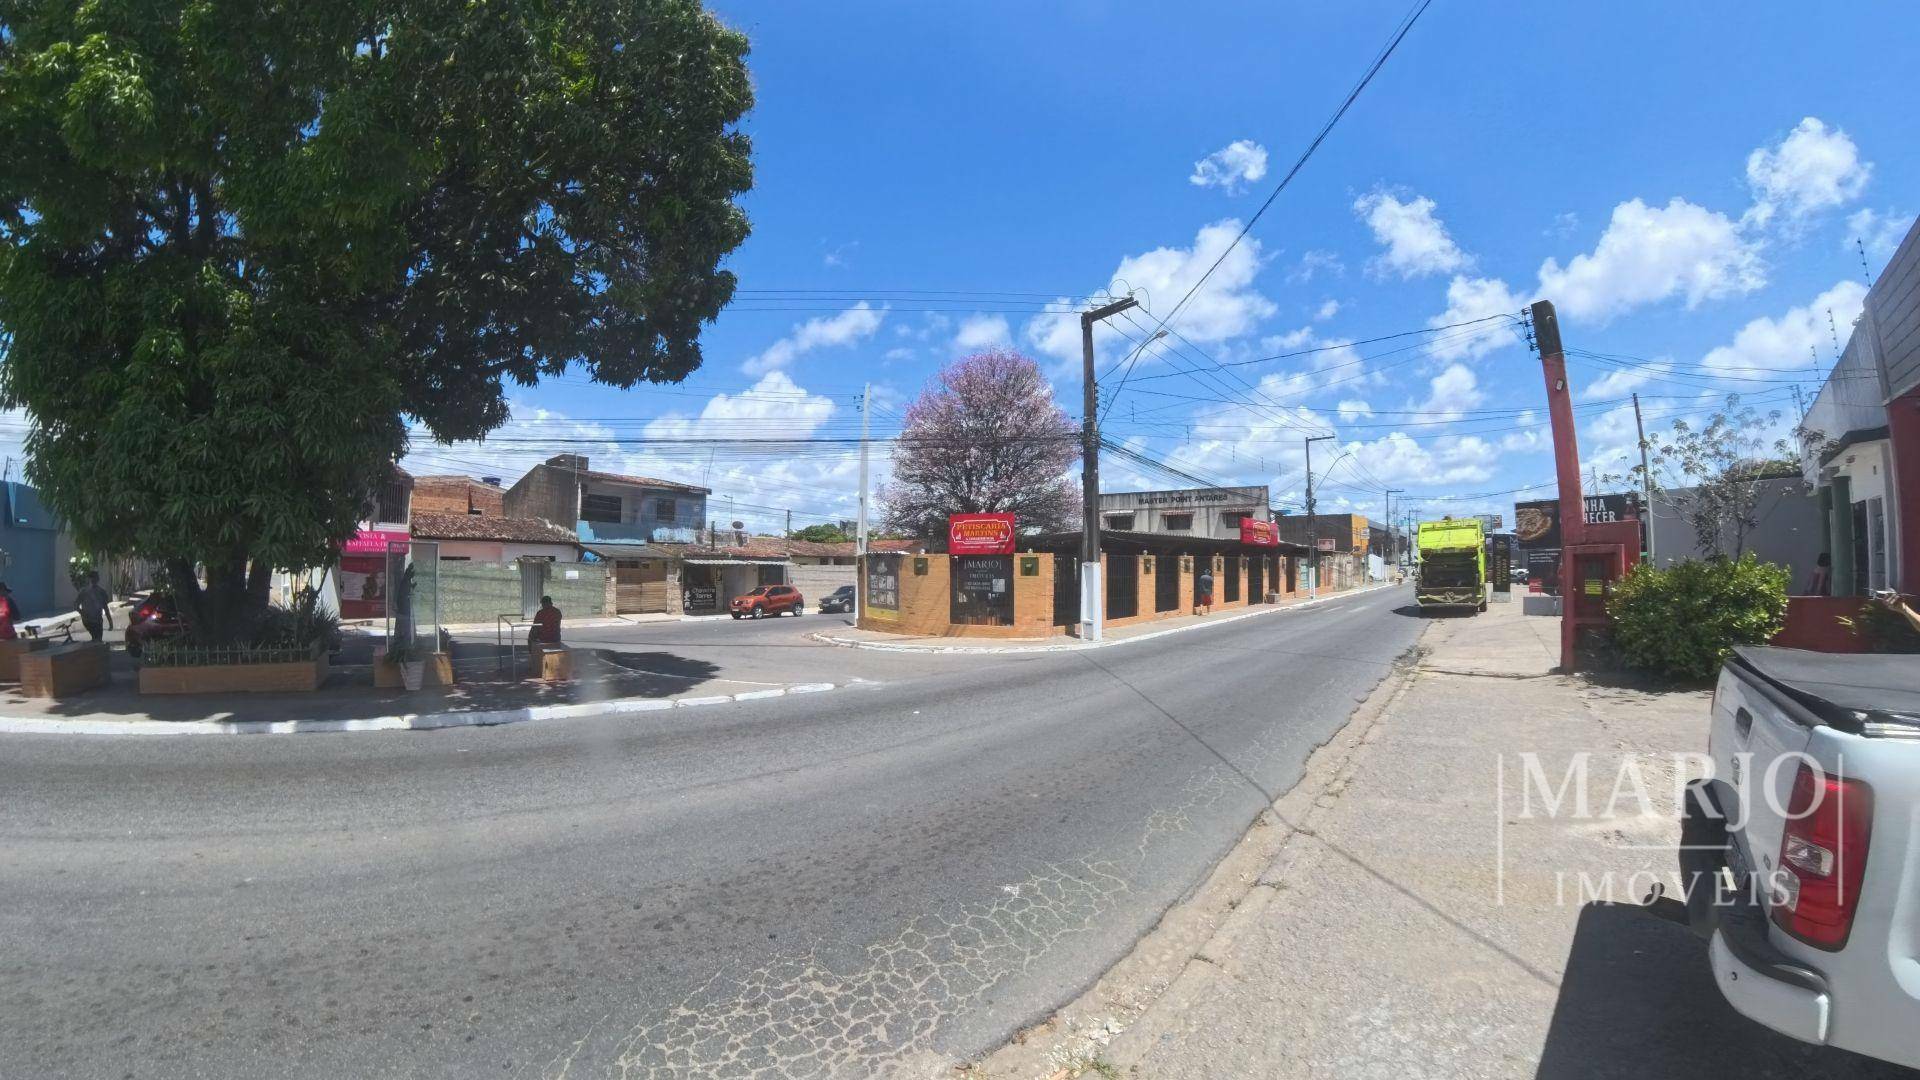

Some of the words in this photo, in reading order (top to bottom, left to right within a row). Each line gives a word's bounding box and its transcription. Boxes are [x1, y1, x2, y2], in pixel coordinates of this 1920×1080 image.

[1138, 496, 1168, 505] MASTER
[1171, 495, 1193, 503] POINT
[1195, 493, 1228, 502] ANTARES
[1583, 498, 1606, 513] NHA
